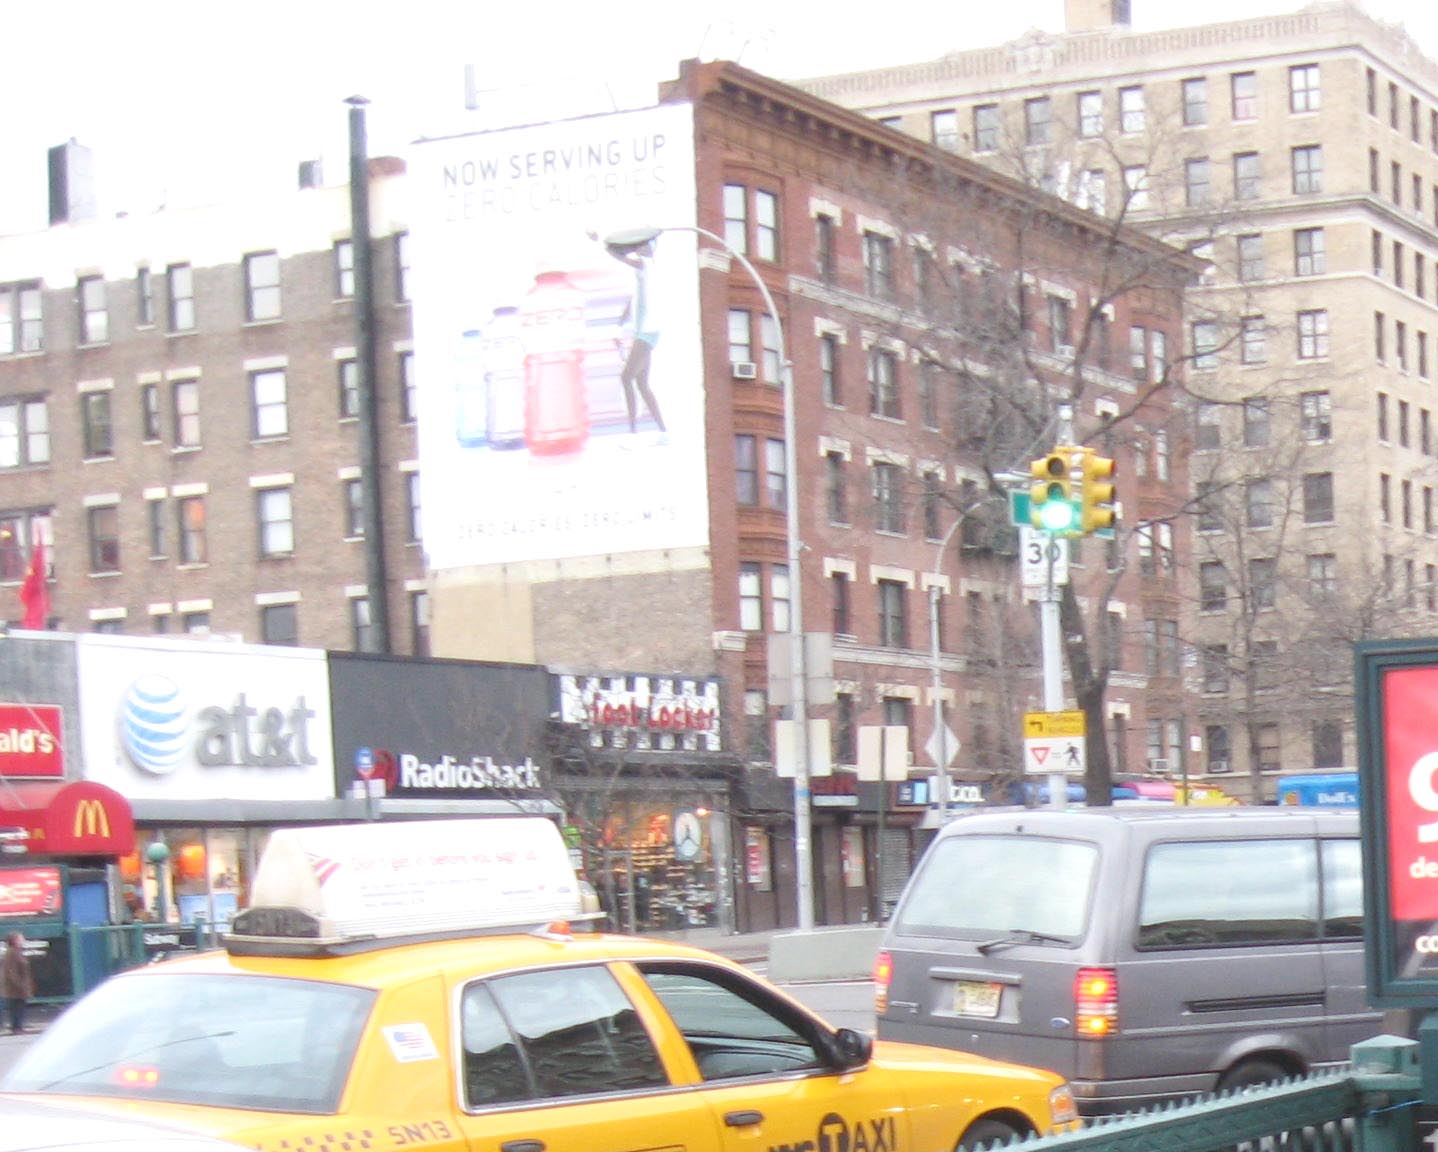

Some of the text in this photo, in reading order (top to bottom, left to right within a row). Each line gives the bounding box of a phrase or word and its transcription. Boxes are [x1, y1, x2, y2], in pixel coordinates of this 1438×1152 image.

[443, 133, 666, 188] NOW SERVING UP
[446, 166, 666, 222] ZERO CALORIES
[1027, 542, 1060, 564] 30
[0, 728, 54, 754] ald's
[196, 692, 319, 767] at&t
[400, 753, 541, 788] RadioShack
